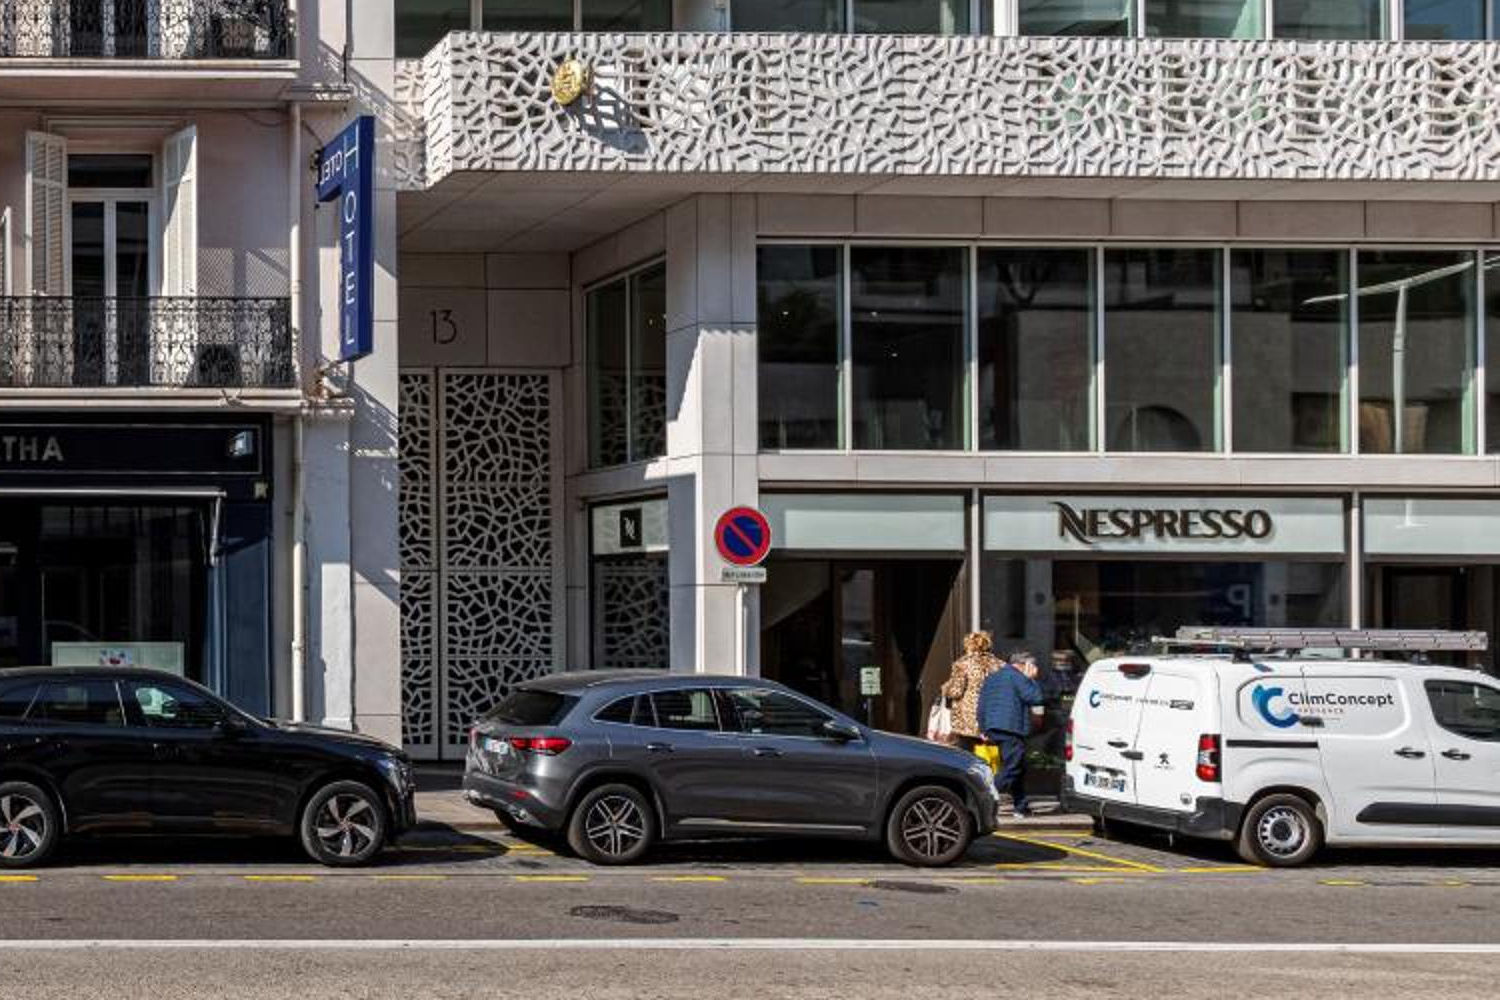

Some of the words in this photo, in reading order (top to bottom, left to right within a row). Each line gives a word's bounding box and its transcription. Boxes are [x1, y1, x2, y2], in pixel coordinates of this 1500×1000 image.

[343, 123, 359, 345] HOTEL
[429, 309, 457, 345] 13
[1049, 500, 1273, 545] NESPRESSO
[1288, 692, 1394, 707] ClimConcept
